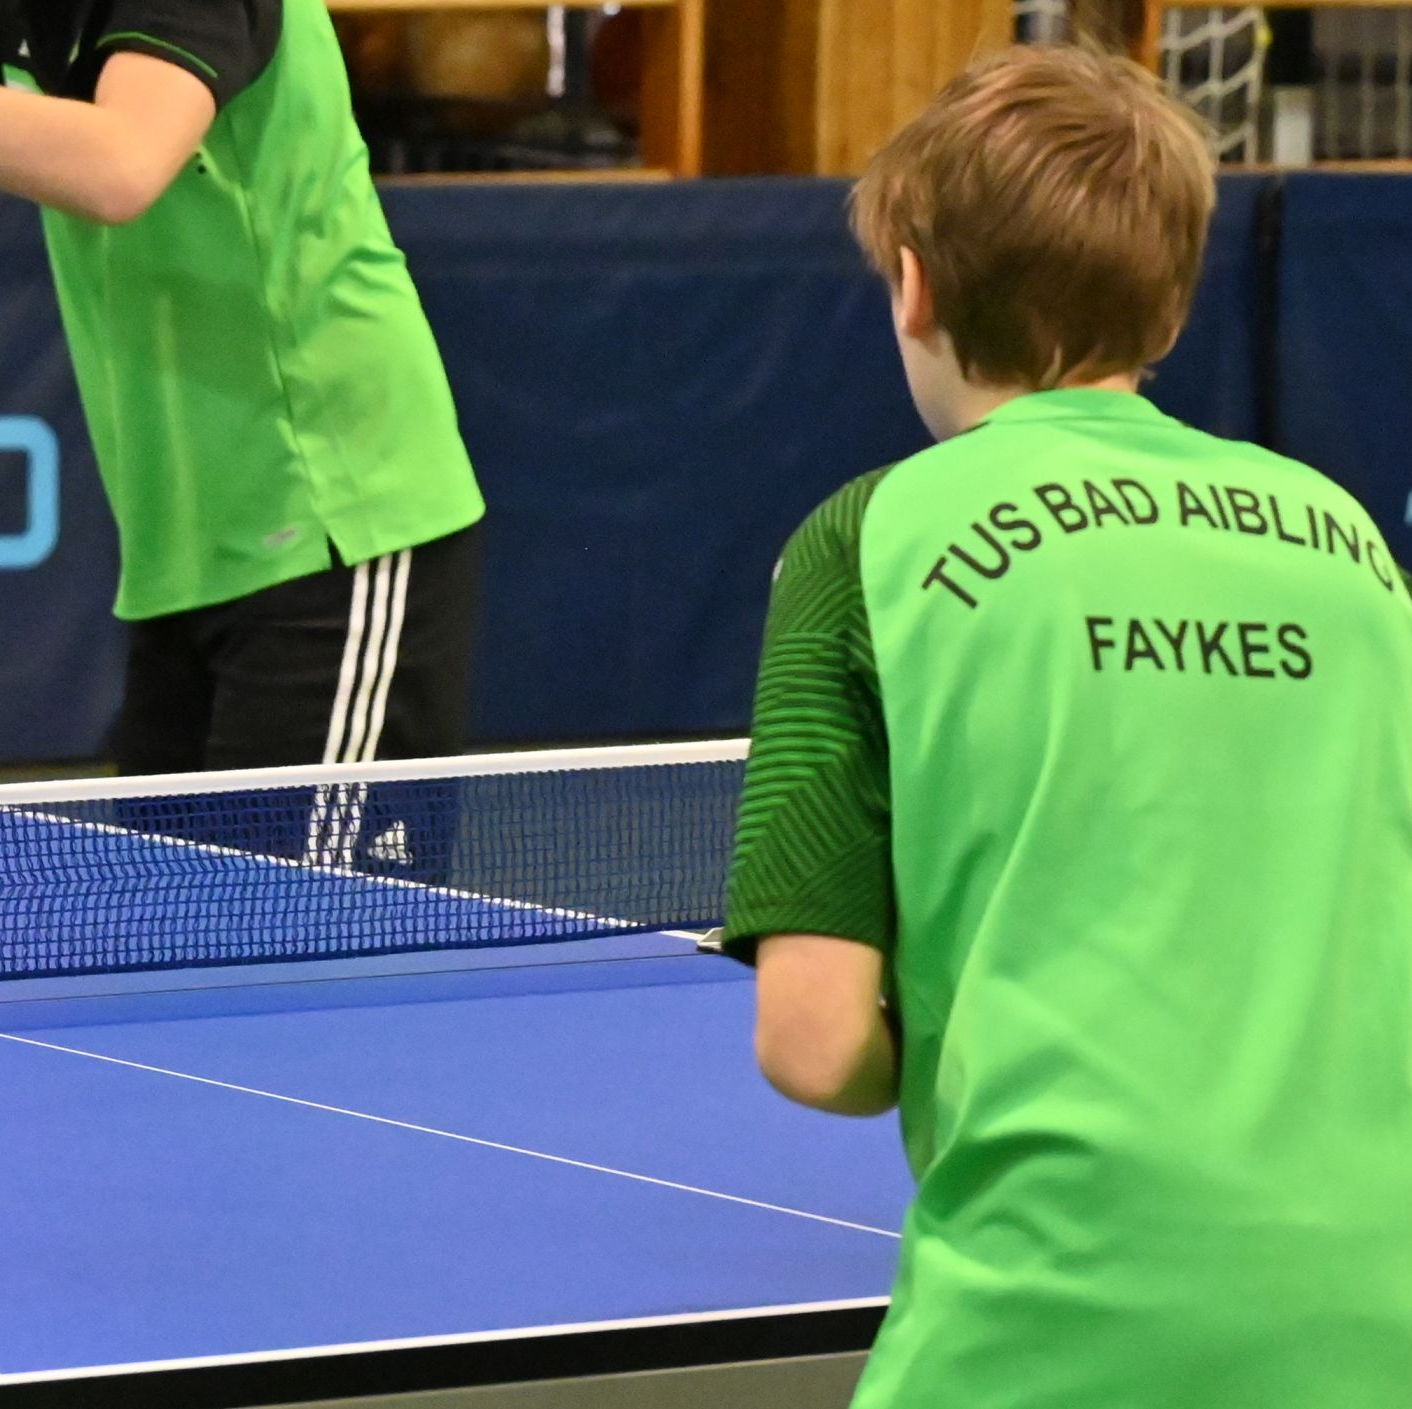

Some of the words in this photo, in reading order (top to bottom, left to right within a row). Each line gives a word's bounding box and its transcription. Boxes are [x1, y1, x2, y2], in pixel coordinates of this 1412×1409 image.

[921, 500, 1043, 610] TUS
[1034, 478, 1161, 535] BAD
[1085, 615, 1313, 681] FAYKES
